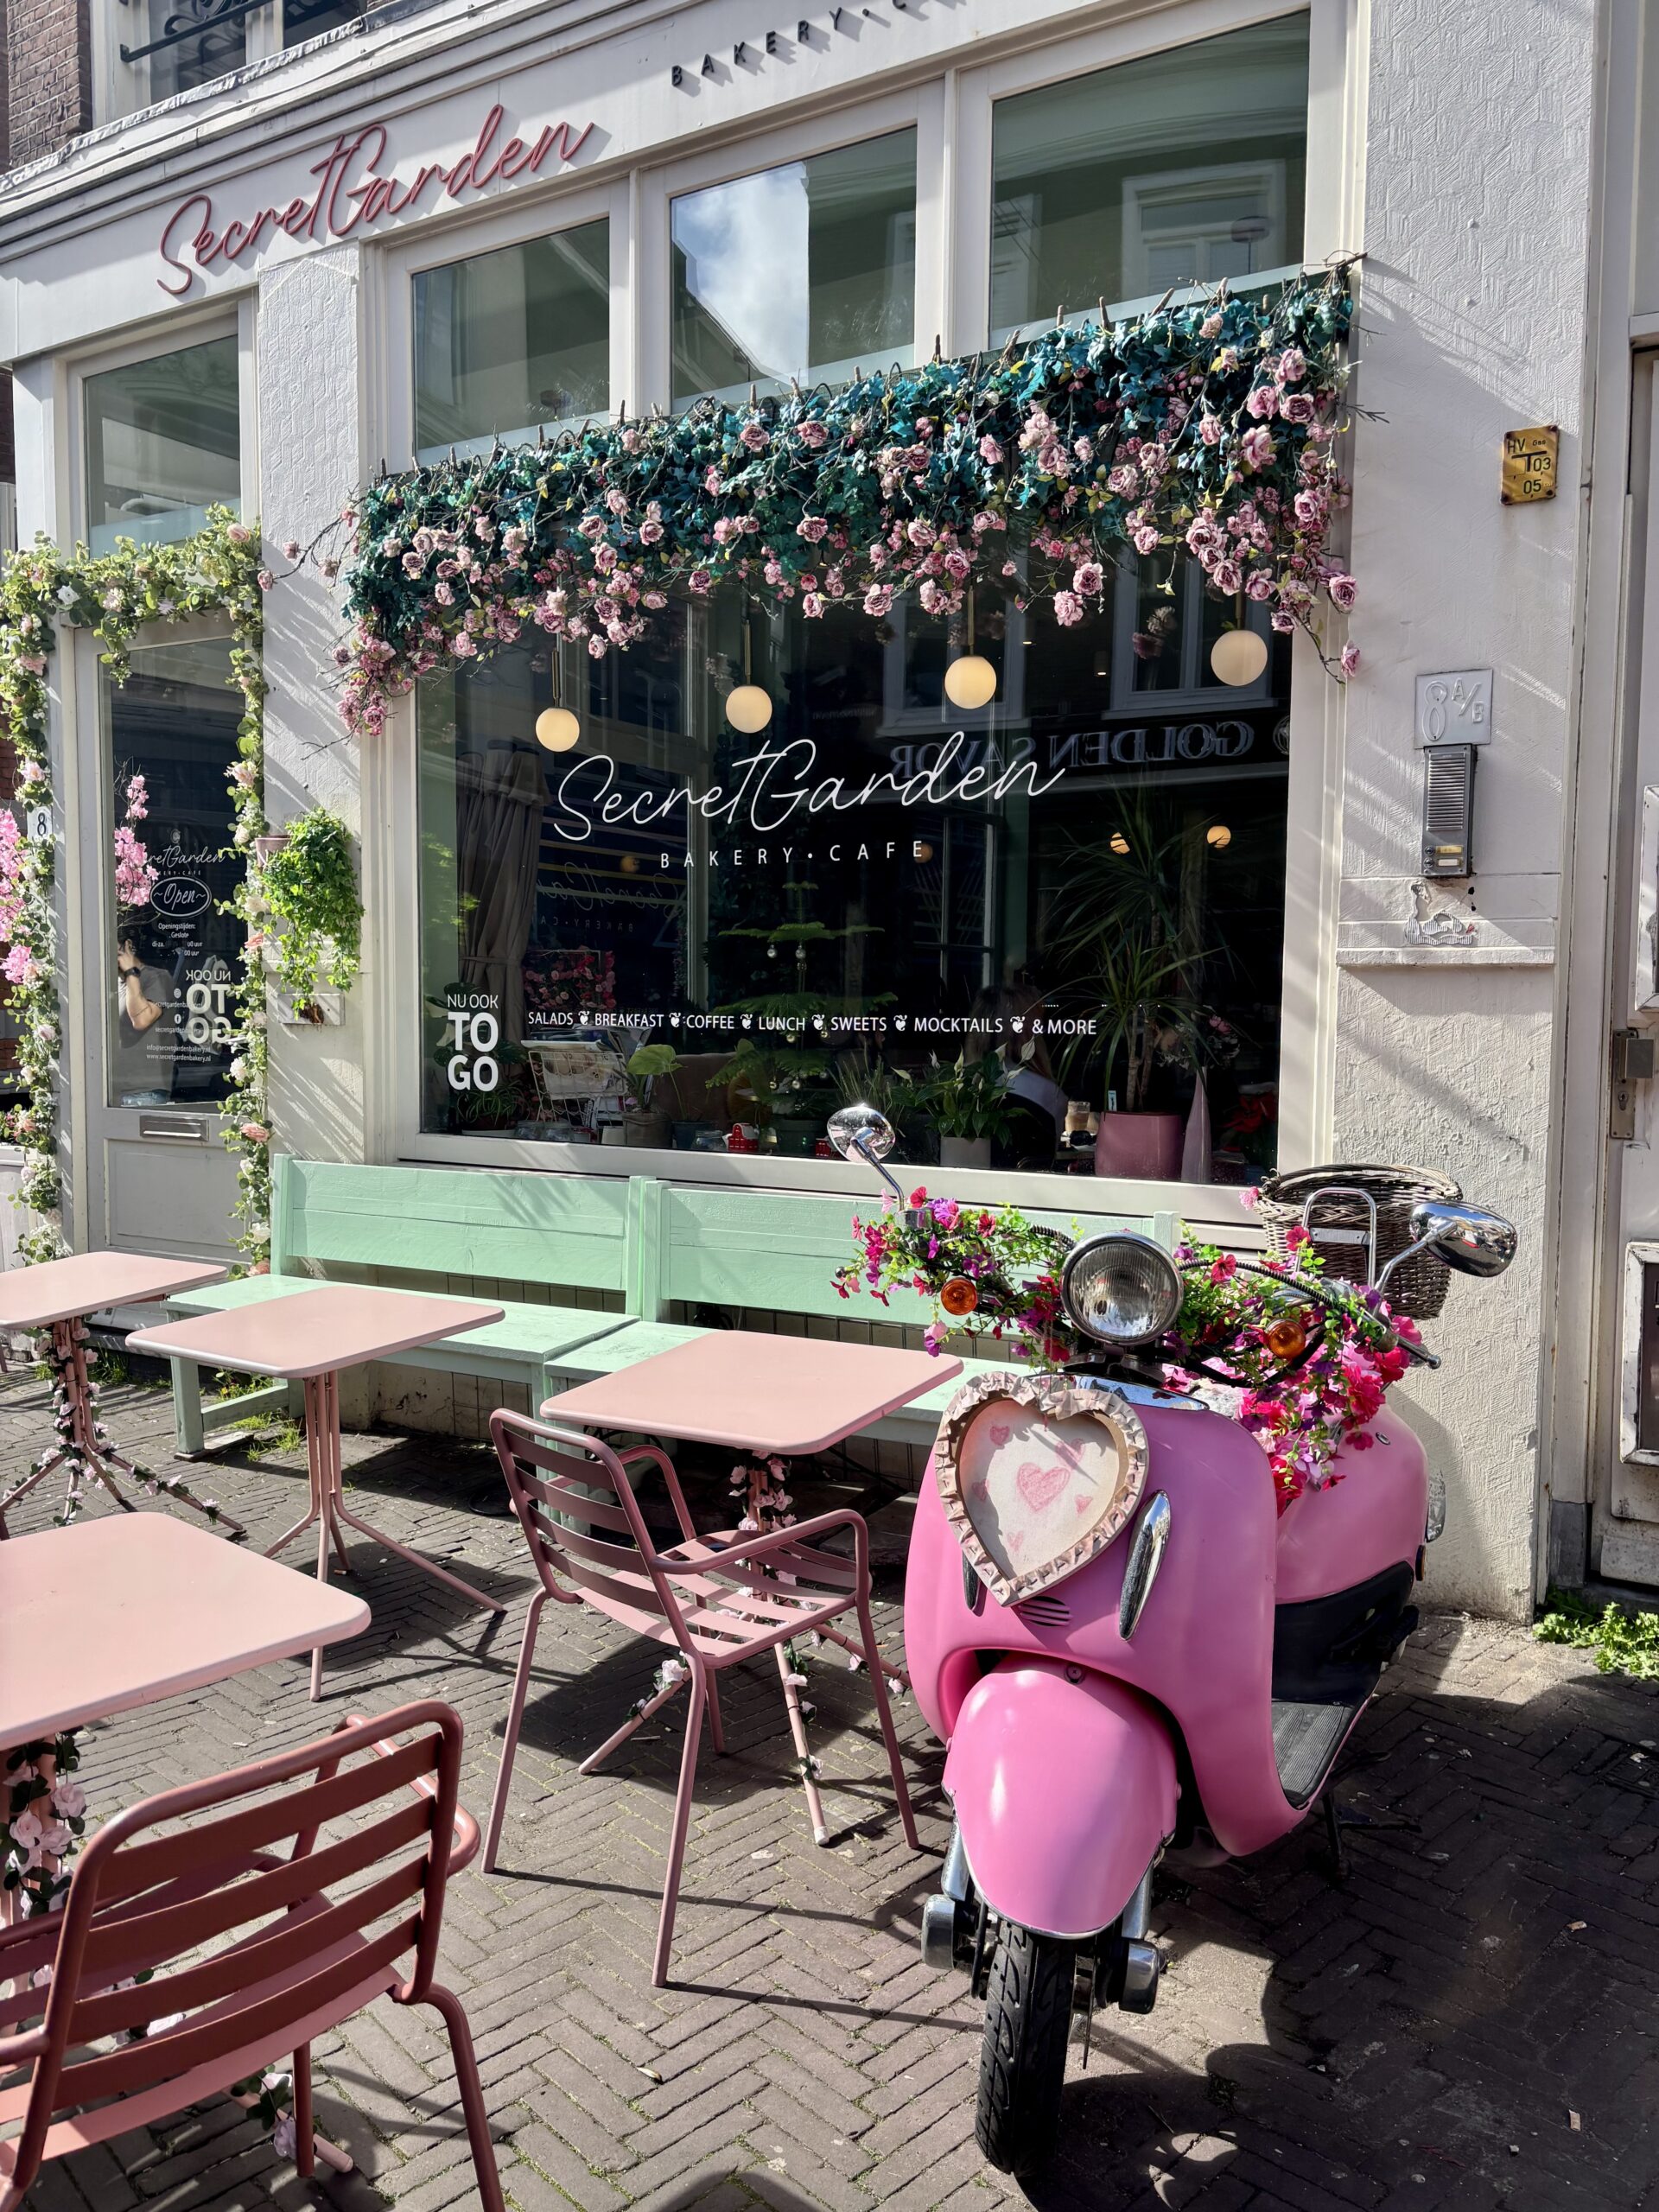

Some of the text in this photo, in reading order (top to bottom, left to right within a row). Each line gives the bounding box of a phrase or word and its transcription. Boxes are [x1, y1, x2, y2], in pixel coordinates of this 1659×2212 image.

[671, 7, 843, 86] BAKERY
[1507, 437, 1526, 454] HV
[1422, 680, 1448, 741] 8
[37, 812, 47, 836] 8
[660, 840, 923, 869] BAKERY CAFE
[447, 994, 499, 1009] NU OOK
[447, 1012, 499, 1052] TO
[527, 1011, 1097, 1035] SALADS BREAKFAST COFFEE LUNCH SWEETS MOCKTAILS & MORE
[447, 1055, 499, 1091] GO
